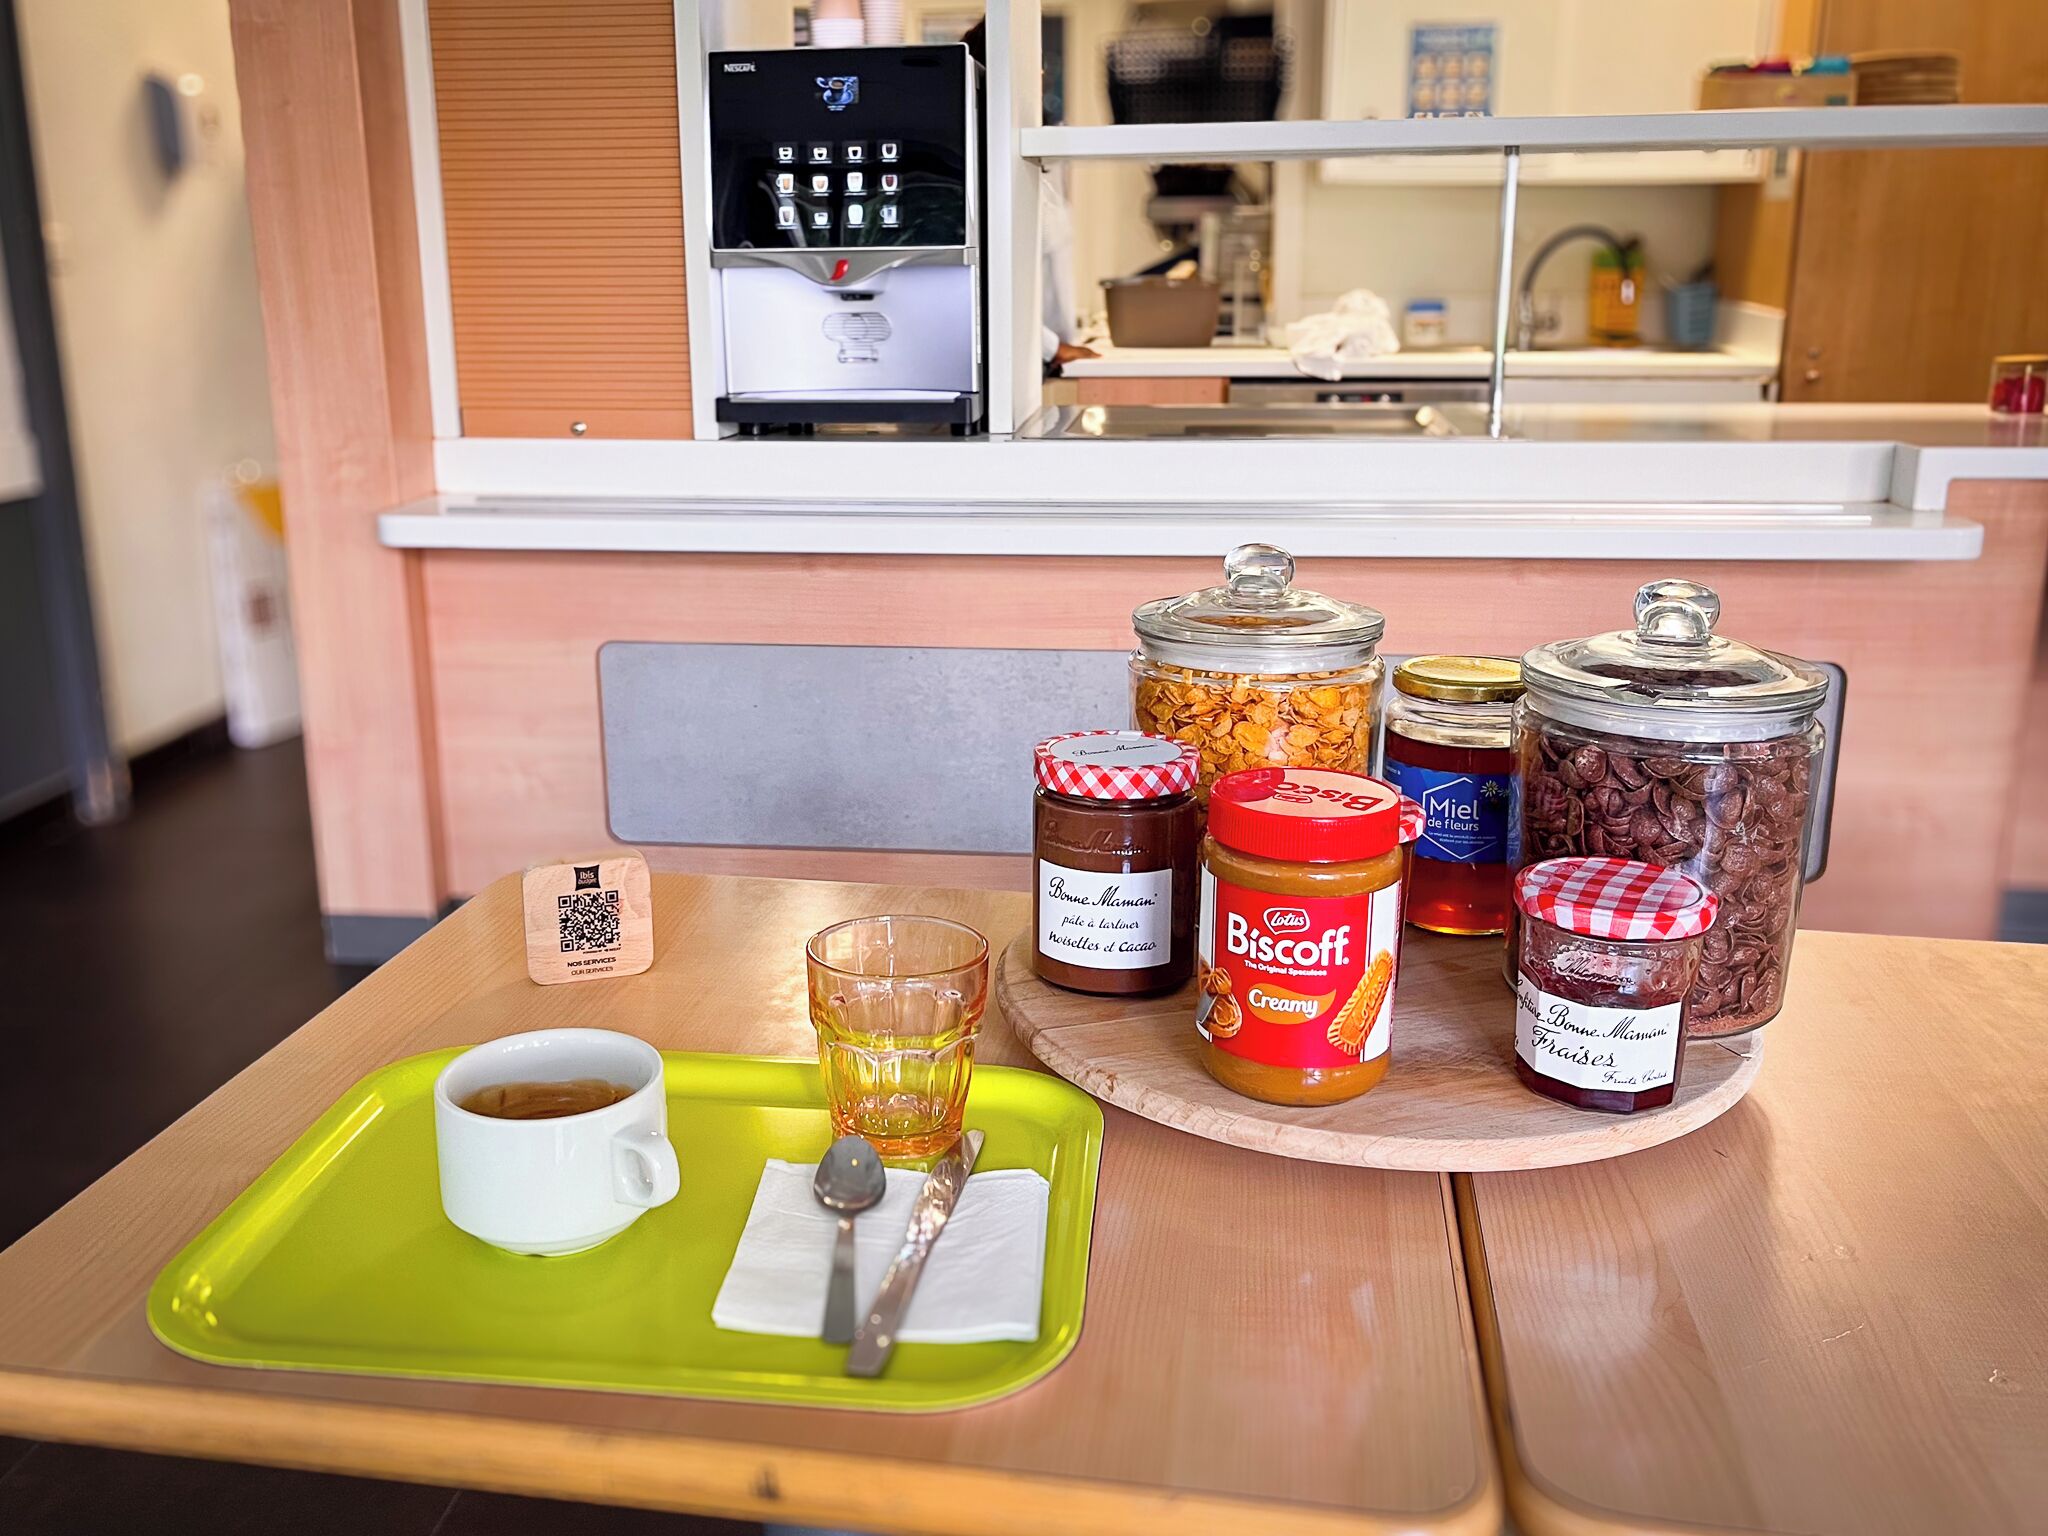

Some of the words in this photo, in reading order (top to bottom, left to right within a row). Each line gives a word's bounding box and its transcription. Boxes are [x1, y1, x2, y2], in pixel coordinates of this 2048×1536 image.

[1429, 796, 1479, 820] Miel
[1427, 817, 1442, 828] de
[1444, 819, 1479, 831] fleurs
[1049, 876, 1090, 905] Bonne
[1061, 915, 1085, 927] pâte
[1087, 919, 1095, 928] à
[1098, 918, 1140, 929] tartiner
[1270, 911, 1305, 927] Lotus
[1103, 941, 1115, 952] et
[1228, 911, 1351, 967] Biscoff
[567, 960, 583, 968] NOS
[583, 956, 617, 966] SERVICES
[1244, 959, 1257, 969] The
[1257, 963, 1287, 975] Original
[571, 968, 585, 976] OUR
[585, 966, 614, 975] SERVICES
[1248, 988, 1318, 1019] Creamy
[1547, 1004, 1600, 1038] Bonne
[1532, 1025, 1618, 1068] Fraises
[1602, 1071, 1637, 1085] Fruits
